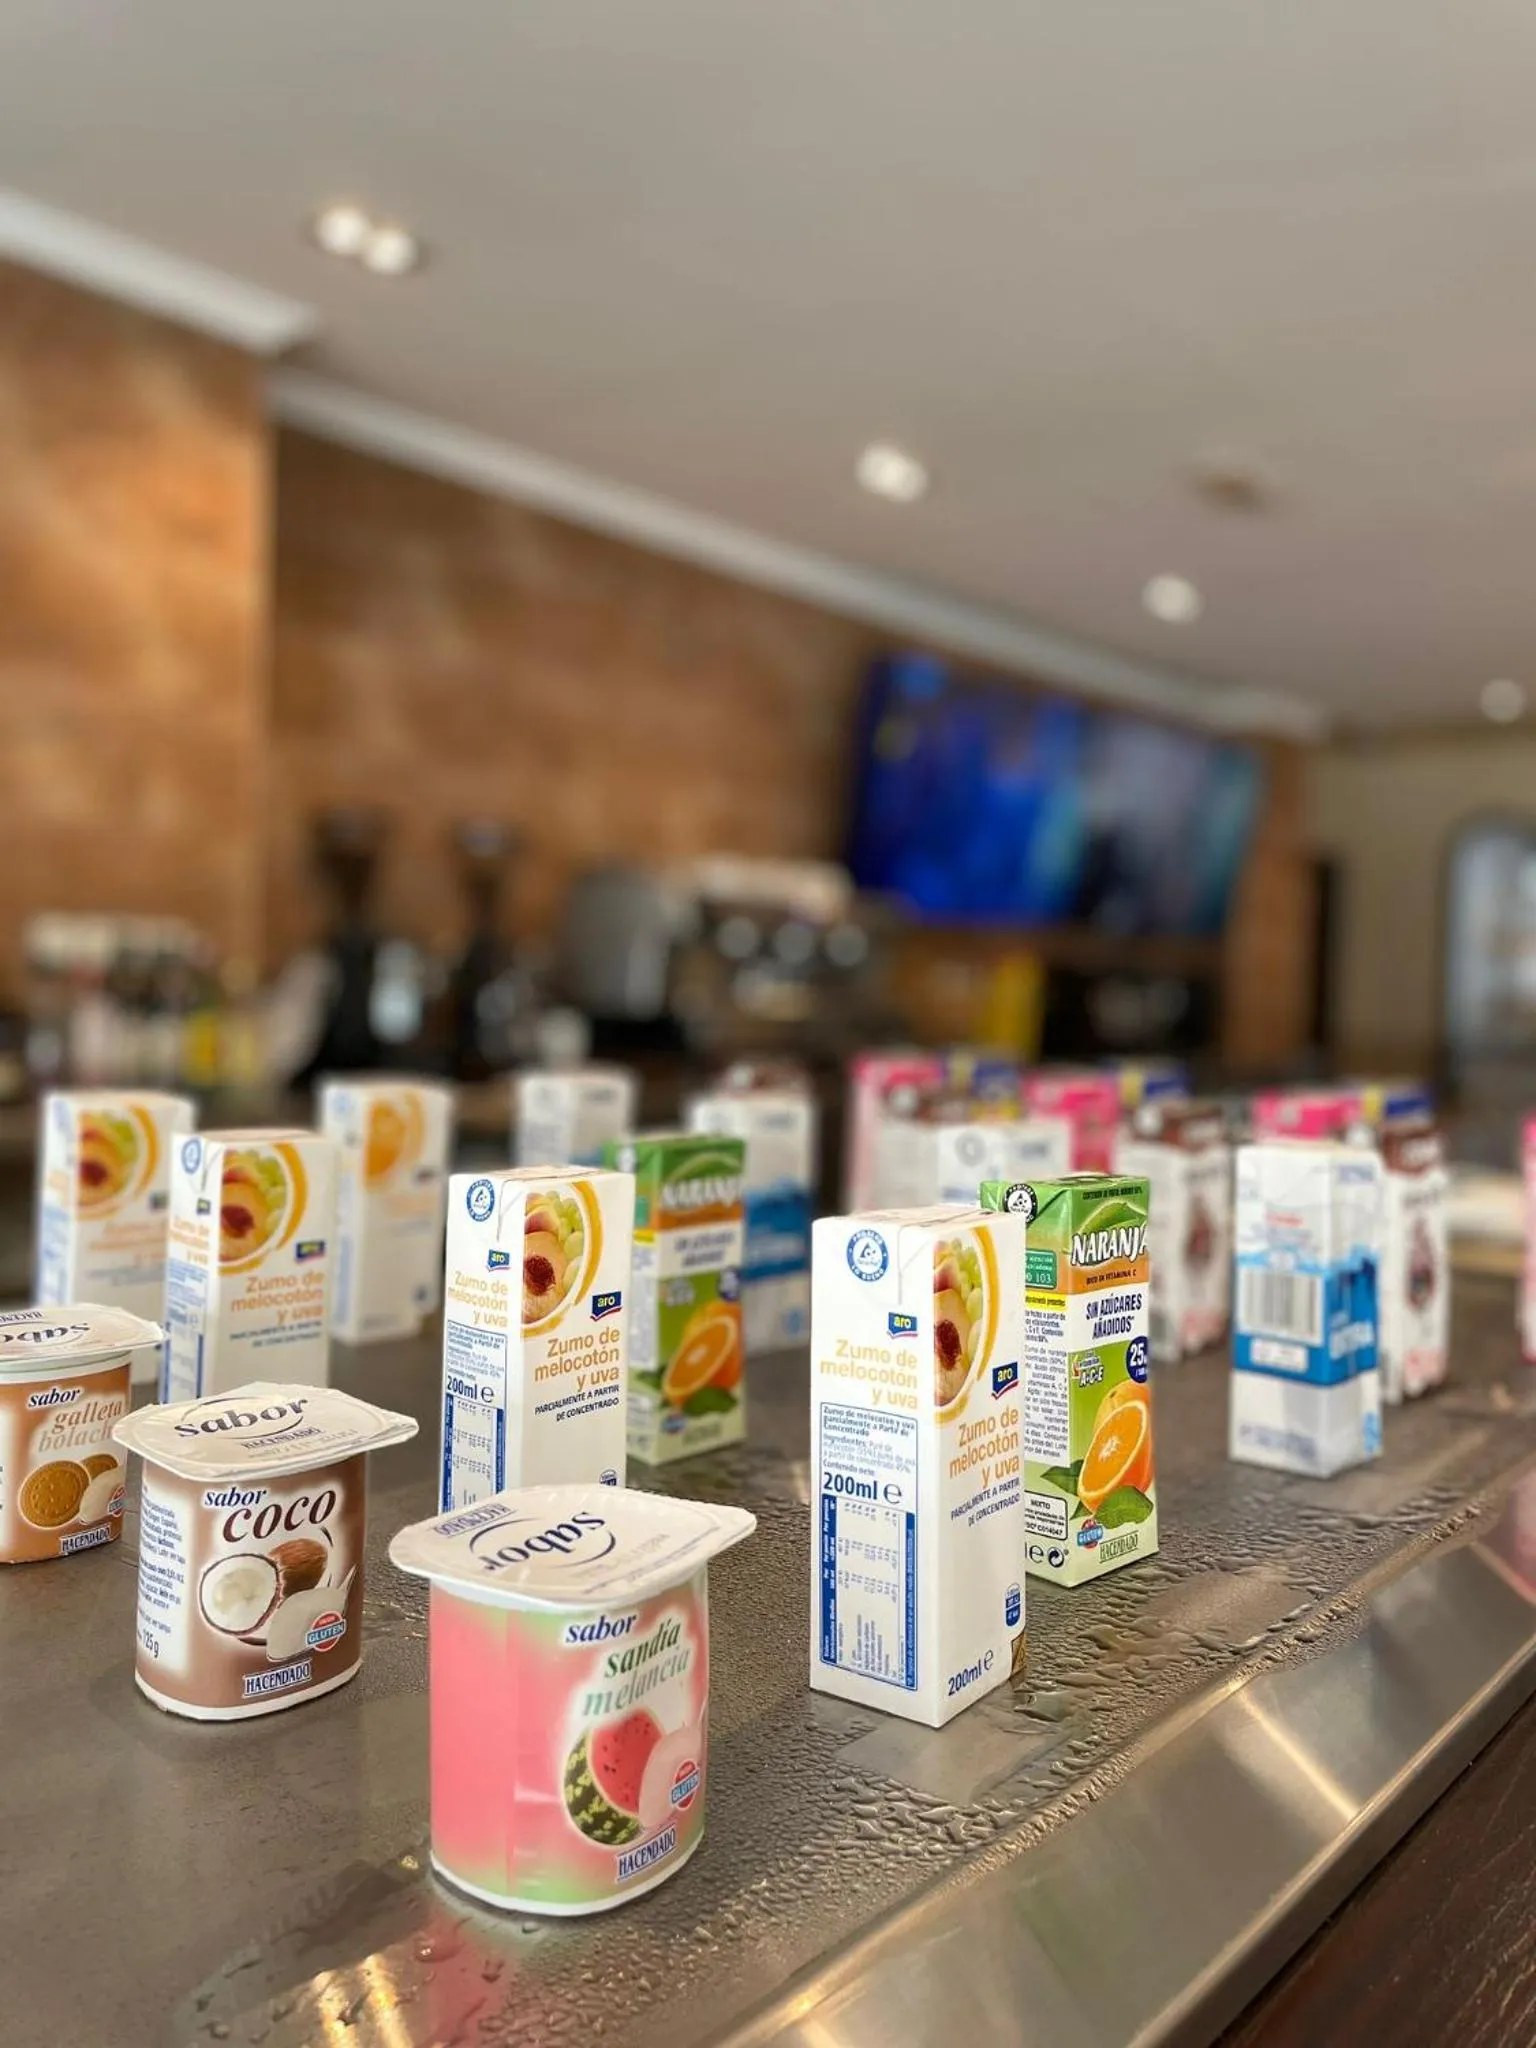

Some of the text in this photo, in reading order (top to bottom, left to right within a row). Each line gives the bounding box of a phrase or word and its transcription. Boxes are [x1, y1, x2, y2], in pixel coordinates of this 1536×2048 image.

[1071, 1222, 1148, 1266] NARANJA
[454, 1270, 509, 1295] Zumo de
[597, 1296, 616, 1308] aro
[1086, 1301, 1099, 1320] SIN
[1100, 1292, 1142, 1317] AZÚCARES
[484, 1313, 508, 1328] uva
[894, 1315, 912, 1328] aro
[548, 1327, 620, 1358] Zumo de
[835, 1339, 918, 1369] Zumo de
[535, 1345, 620, 1382] melocotón
[820, 1360, 918, 1389] melocotón
[997, 1366, 1013, 1382] aro
[577, 1366, 620, 1392] y uva
[28, 1388, 81, 1408] sabor
[535, 1384, 620, 1415] PARCIALMENTE A PARTIR
[556, 1397, 620, 1422] DE CONCENTRADO
[872, 1387, 918, 1410] y uva
[52, 1400, 122, 1435] galleta
[174, 1398, 308, 1437] sabor
[959, 1405, 1019, 1448] Zumo de
[39, 1420, 113, 1453] bolach
[950, 1429, 1019, 1479] melocotón
[824, 1471, 878, 1500] 200ml
[982, 1454, 1020, 1489] y uva
[204, 1487, 267, 1507] sabor
[951, 1488, 991, 1520] PARCIALMENTE
[992, 1486, 998, 1496] A
[976, 1493, 1020, 1521] CONCENTRADO
[223, 1490, 337, 1543] coco
[62, 1528, 110, 1553] HACENDADO
[478, 1511, 606, 1571] sabor
[1100, 1534, 1138, 1561] HACENDADO
[309, 1623, 344, 1643] GLUTEN
[566, 1614, 637, 1643] sabor
[604, 1618, 681, 1678] sandía
[246, 1663, 310, 1694] HACENDADO
[583, 1647, 689, 1716] melancia
[948, 1659, 982, 1697] 200ml
[619, 1828, 676, 1876] HACENDADO
